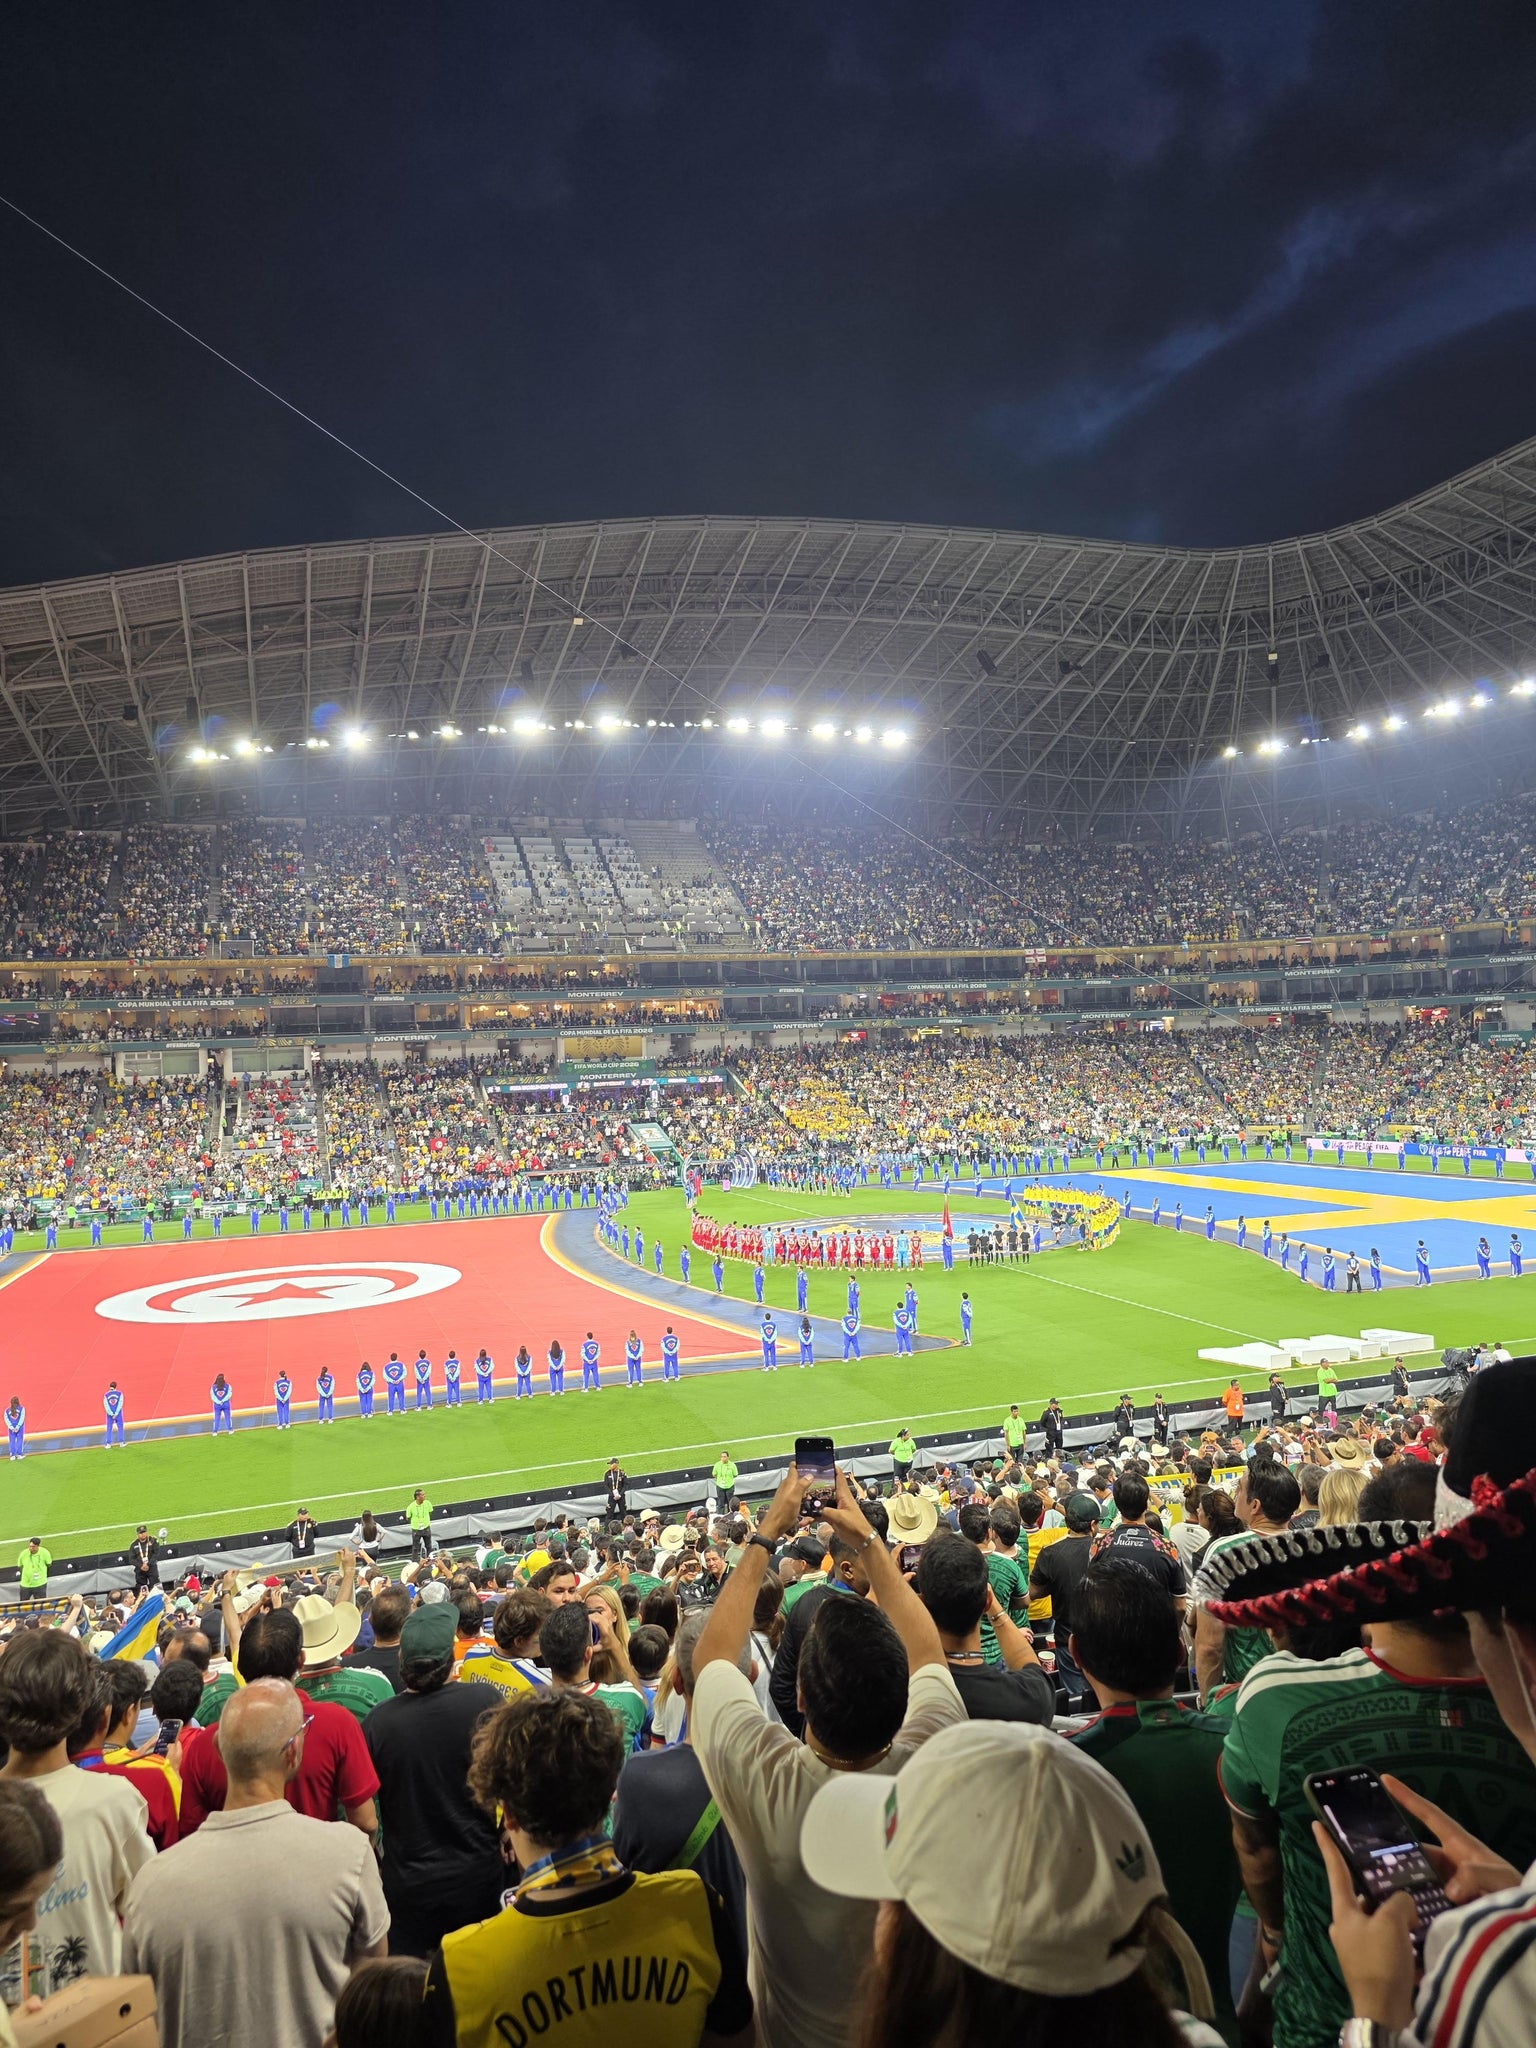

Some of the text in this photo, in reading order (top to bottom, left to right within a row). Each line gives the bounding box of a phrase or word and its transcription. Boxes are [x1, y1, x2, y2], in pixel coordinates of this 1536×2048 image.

[138, 1000, 171, 1008] MUNDIAL
[1472, 1149, 1487, 1157] FIFA
[1113, 1534, 1144, 1547] Juárez
[495, 1955, 690, 2048] DORTMUND
